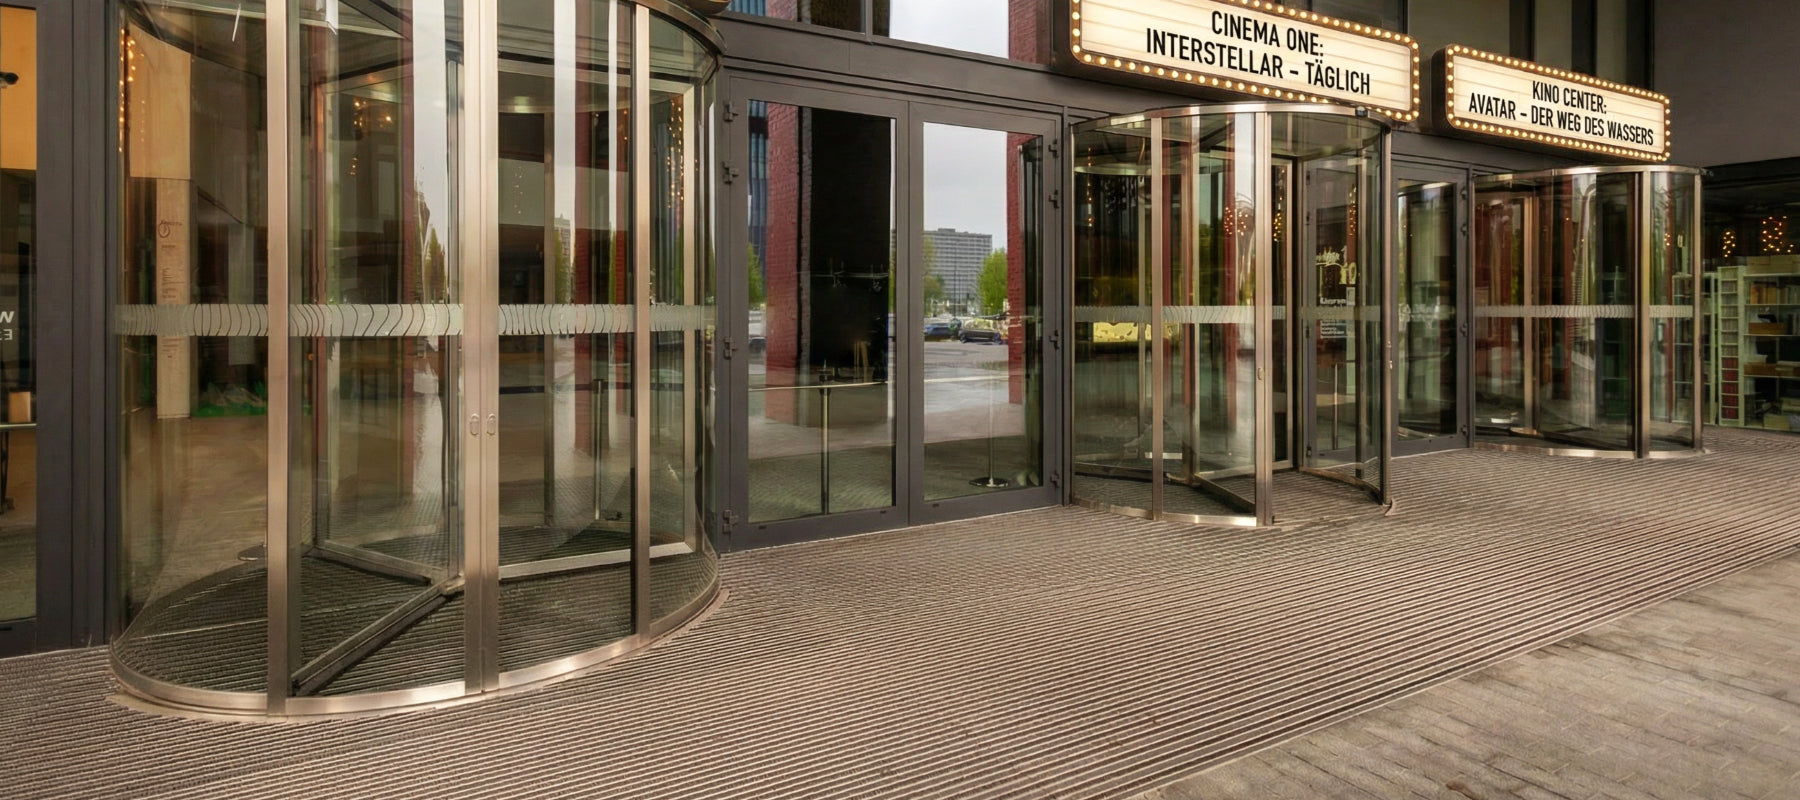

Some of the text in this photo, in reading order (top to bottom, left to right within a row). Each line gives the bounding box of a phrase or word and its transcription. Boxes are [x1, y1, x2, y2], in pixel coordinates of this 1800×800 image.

[1211, 10, 1324, 57] CINEMA ONE:
[1146, 27, 1284, 79] INTERSTELLAR
[1304, 58, 1370, 97] TÄGLICH
[1468, 92, 1516, 121] AVATAR
[1531, 105, 1554, 128] DER
[1556, 110, 1581, 133] WEG
[1584, 115, 1605, 137] DES
[1607, 120, 1655, 146] WASSERS
[1532, 80, 1607, 115] KINO CENTER:
